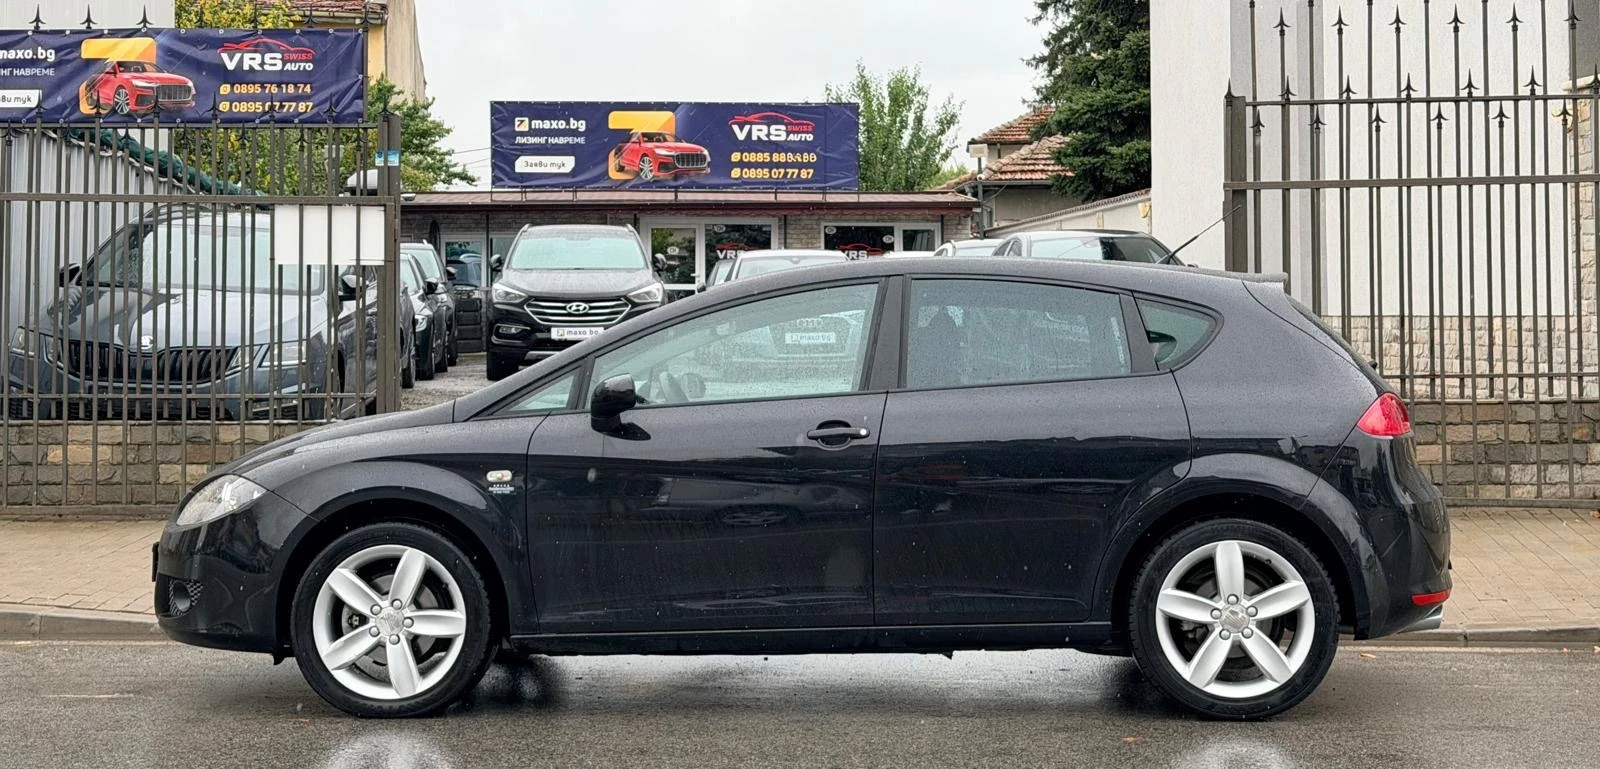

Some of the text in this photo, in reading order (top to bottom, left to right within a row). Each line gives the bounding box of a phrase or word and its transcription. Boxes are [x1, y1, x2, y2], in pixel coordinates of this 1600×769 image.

[220, 53, 282, 70] VRS
[284, 62, 314, 70] AUTO
[13, 68, 55, 76] НАВРЕМЕ
[233, 84, 311, 93] 0895 76 18 74
[232, 102, 262, 112] 0895
[282, 102, 296, 112] 77
[298, 102, 313, 112] 87
[531, 117, 586, 132] maxo.bg
[731, 124, 786, 141] VRS
[787, 133, 814, 141] AUTO
[515, 136, 586, 144] ЛИЗИНГ НАВРЕМЕ
[742, 152, 770, 162] 0885
[742, 168, 814, 178] 0895 07 77 87
